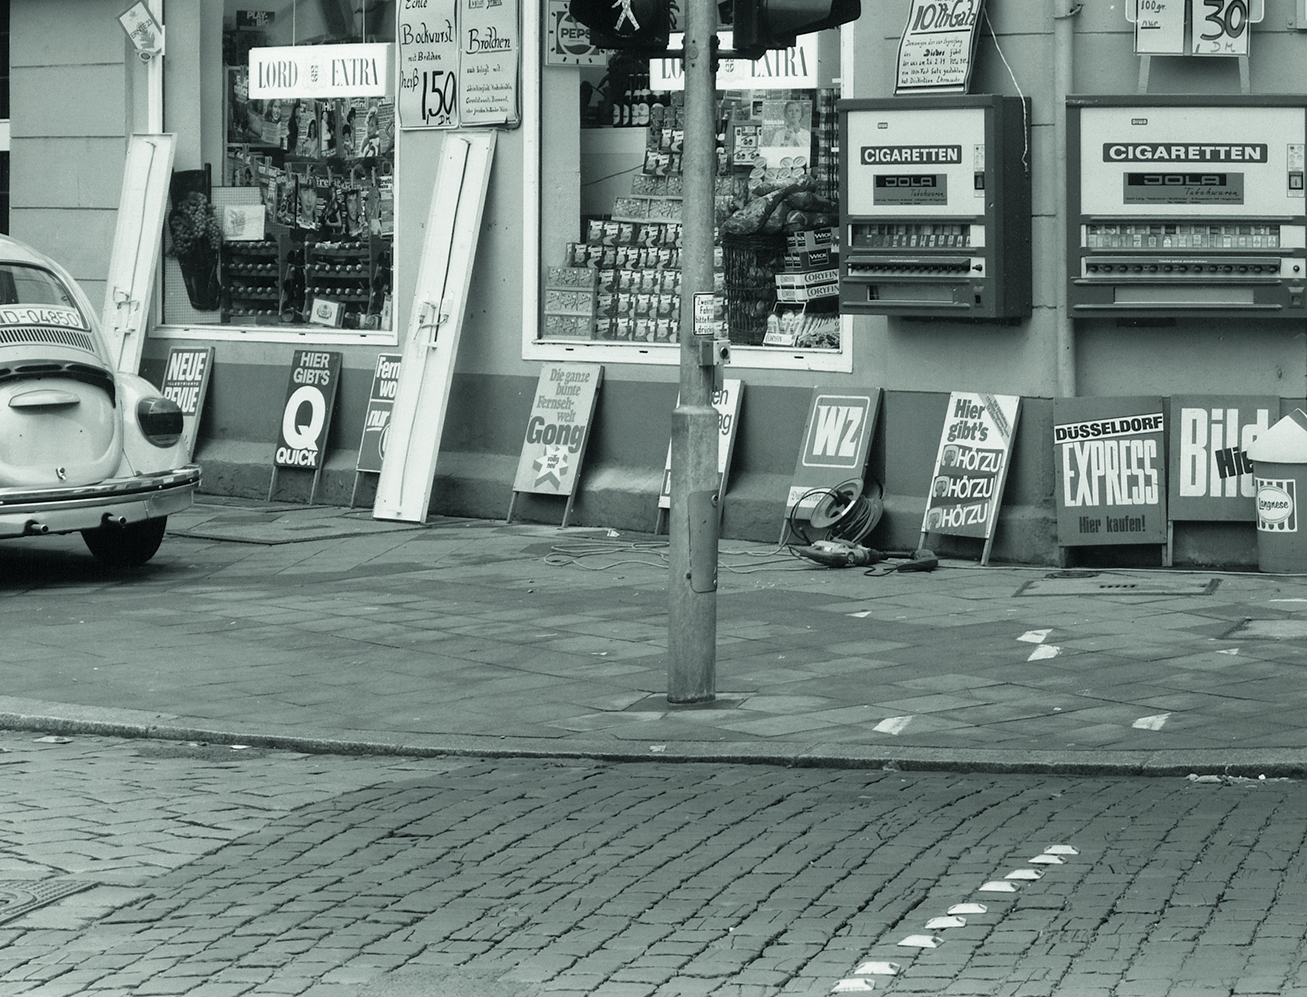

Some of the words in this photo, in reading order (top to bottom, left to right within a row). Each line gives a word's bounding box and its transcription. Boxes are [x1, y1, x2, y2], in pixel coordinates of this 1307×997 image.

[561, 28, 590, 38] PEPS
[259, 61, 298, 88] LORD
[332, 58, 378, 86] EXTRA
[864, 148, 958, 162] CIGARETTEN
[1109, 146, 1261, 160] CIGARETTEN
[886, 177, 932, 186] JOLA
[1144, 176, 1219, 185] JOLA
[805, 271, 838, 282] CORYFIN
[167, 353, 206, 381] NEUE
[301, 353, 329, 368] HIER
[294, 368, 330, 386] GIBT'S
[549, 368, 564, 381] Die
[565, 371, 590, 384] ganze
[556, 383, 581, 396] bunte
[536, 396, 574, 409] Fernseh-
[954, 399, 985, 419] Hier
[282, 386, 326, 450] Q
[368, 410, 390, 426] nur
[557, 409, 576, 422] welt
[526, 416, 585, 453] Gong
[813, 405, 863, 457] WZ
[947, 422, 989, 442] gibt's
[1056, 416, 1162, 441] DÜSSELDORF
[276, 450, 318, 466] QUICK
[1062, 440, 1158, 506] EXPRESS
[1259, 497, 1288, 510] Langnese
[1079, 516, 1100, 533] Hier
[1106, 514, 1146, 533] kaufen!
